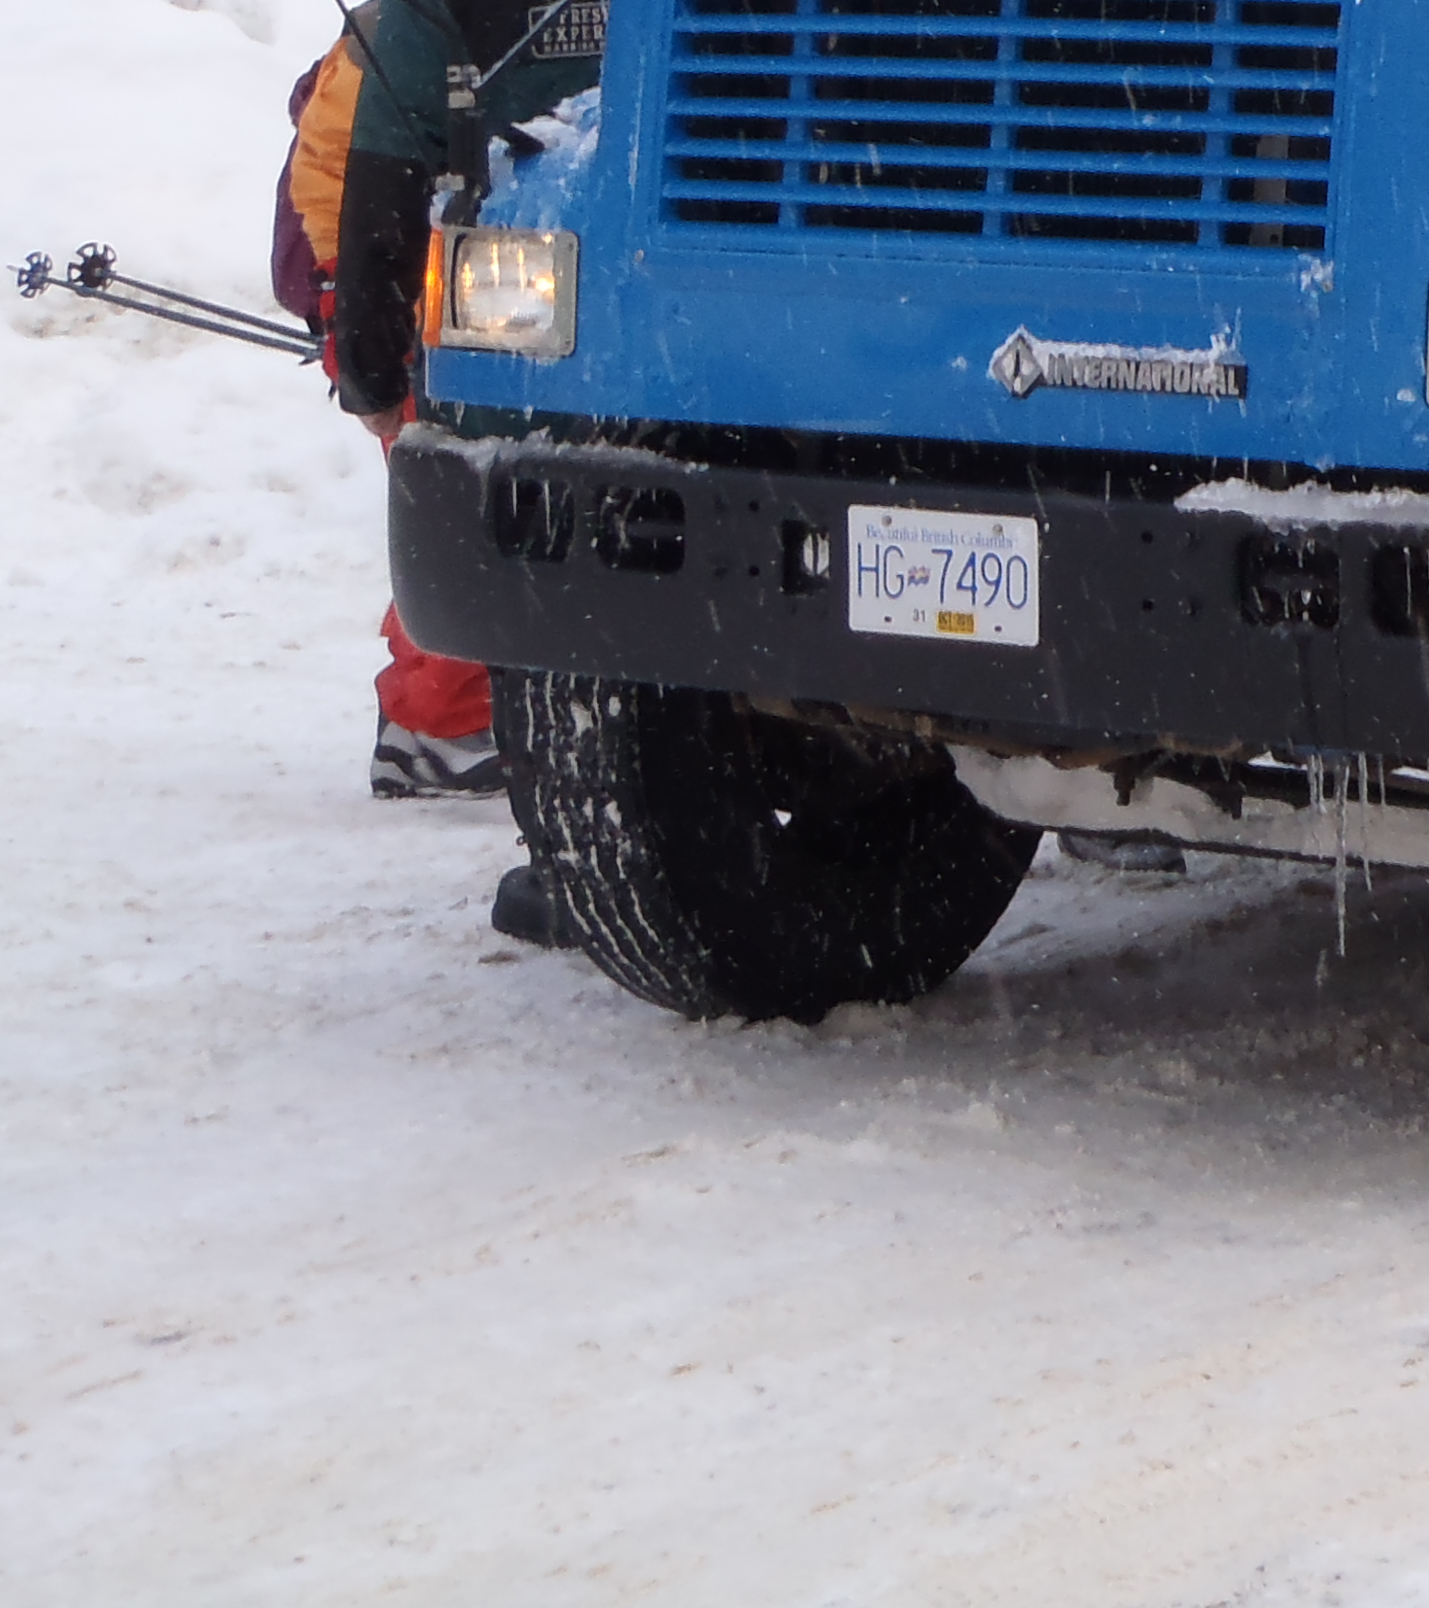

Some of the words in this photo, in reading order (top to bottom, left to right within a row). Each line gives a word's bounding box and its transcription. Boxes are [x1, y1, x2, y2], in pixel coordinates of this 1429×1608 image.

[1047, 352, 1242, 396] INTERNATIONAL
[857, 543, 904, 599] HG
[931, 548, 1028, 610] 7490
